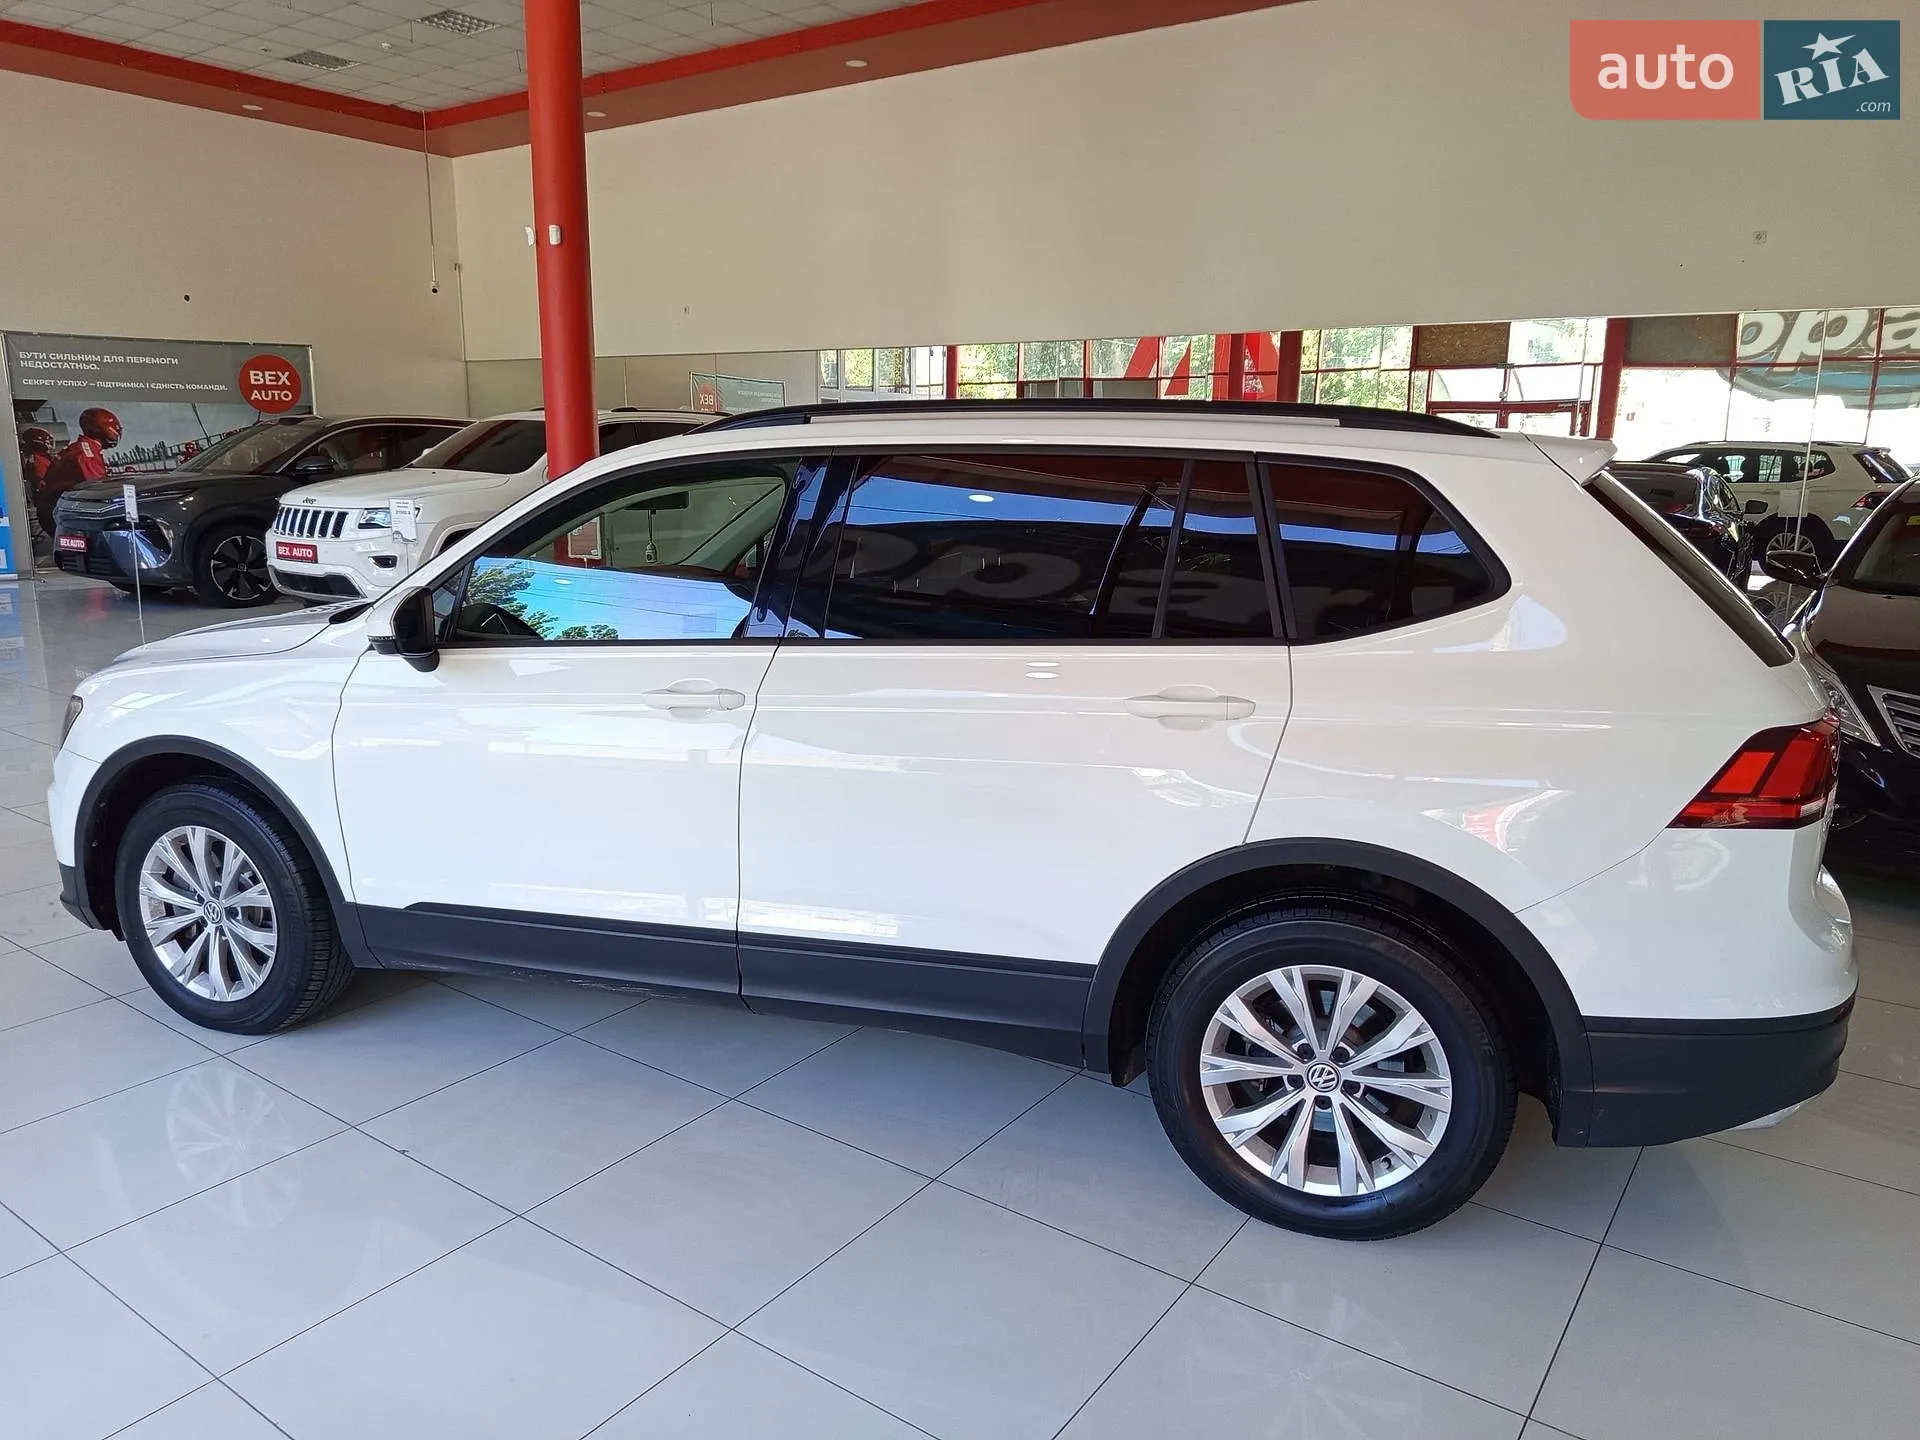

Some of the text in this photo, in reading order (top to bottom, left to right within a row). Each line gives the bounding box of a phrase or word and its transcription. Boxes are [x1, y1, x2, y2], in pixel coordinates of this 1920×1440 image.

[19, 351, 179, 365] БУТИ СИЛЬНИМ ДЛЯ ПЕРЕМОГИ
[20, 360, 101, 370] НЕДОСТАТНЬО.
[22, 378, 56, 386] СЕКРЕТ
[56, 379, 88, 388] УСПІХУ
[96, 381, 145, 389] ПІДТРИМКА
[251, 389, 293, 402] AUTO
[71, 538, 85, 548] AUTO
[278, 546, 313, 559] BEX AUTO
